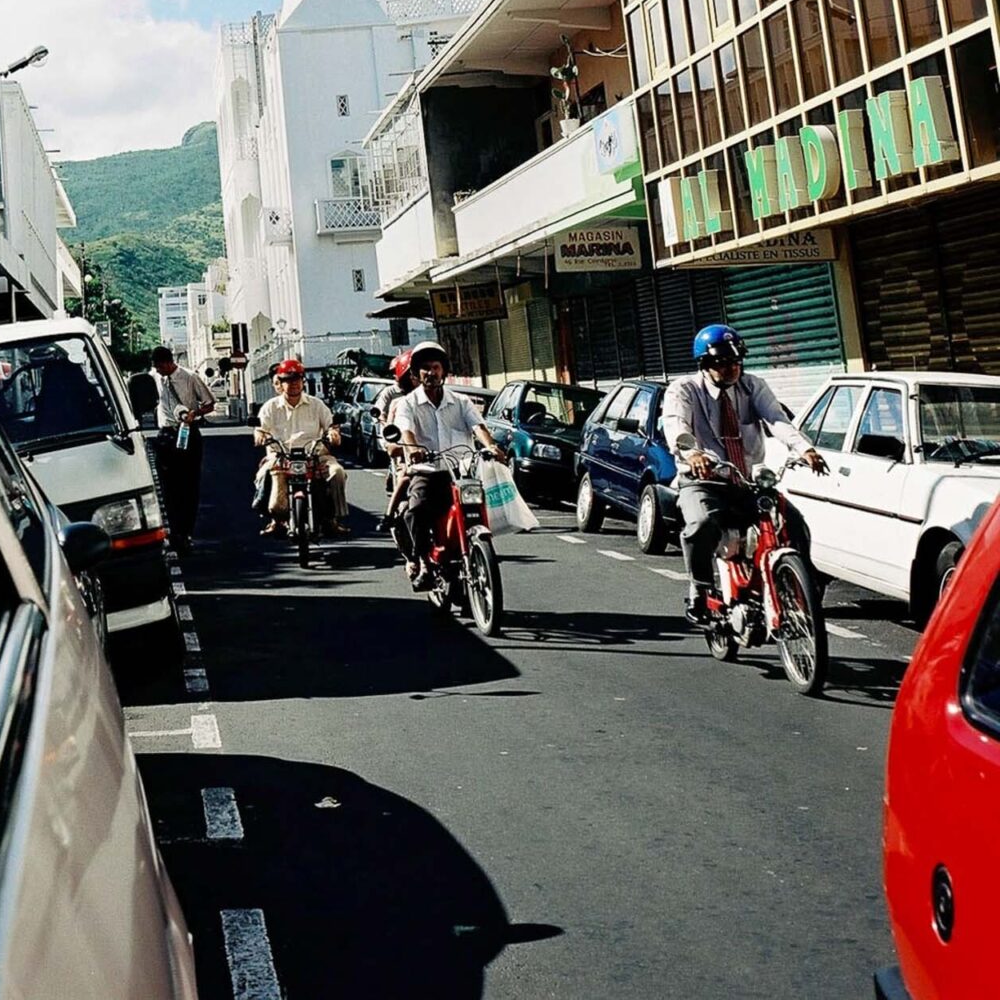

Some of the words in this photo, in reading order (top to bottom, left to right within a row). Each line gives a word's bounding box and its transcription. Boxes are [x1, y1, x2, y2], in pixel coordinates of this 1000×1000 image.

[681, 170, 722, 241] AL
[745, 76, 945, 220] MADINA
[568, 230, 624, 242] MAGASIN
[560, 242, 635, 258] MARINA
[763, 249, 779, 259] EN
[784, 248, 820, 259] TISSUS
